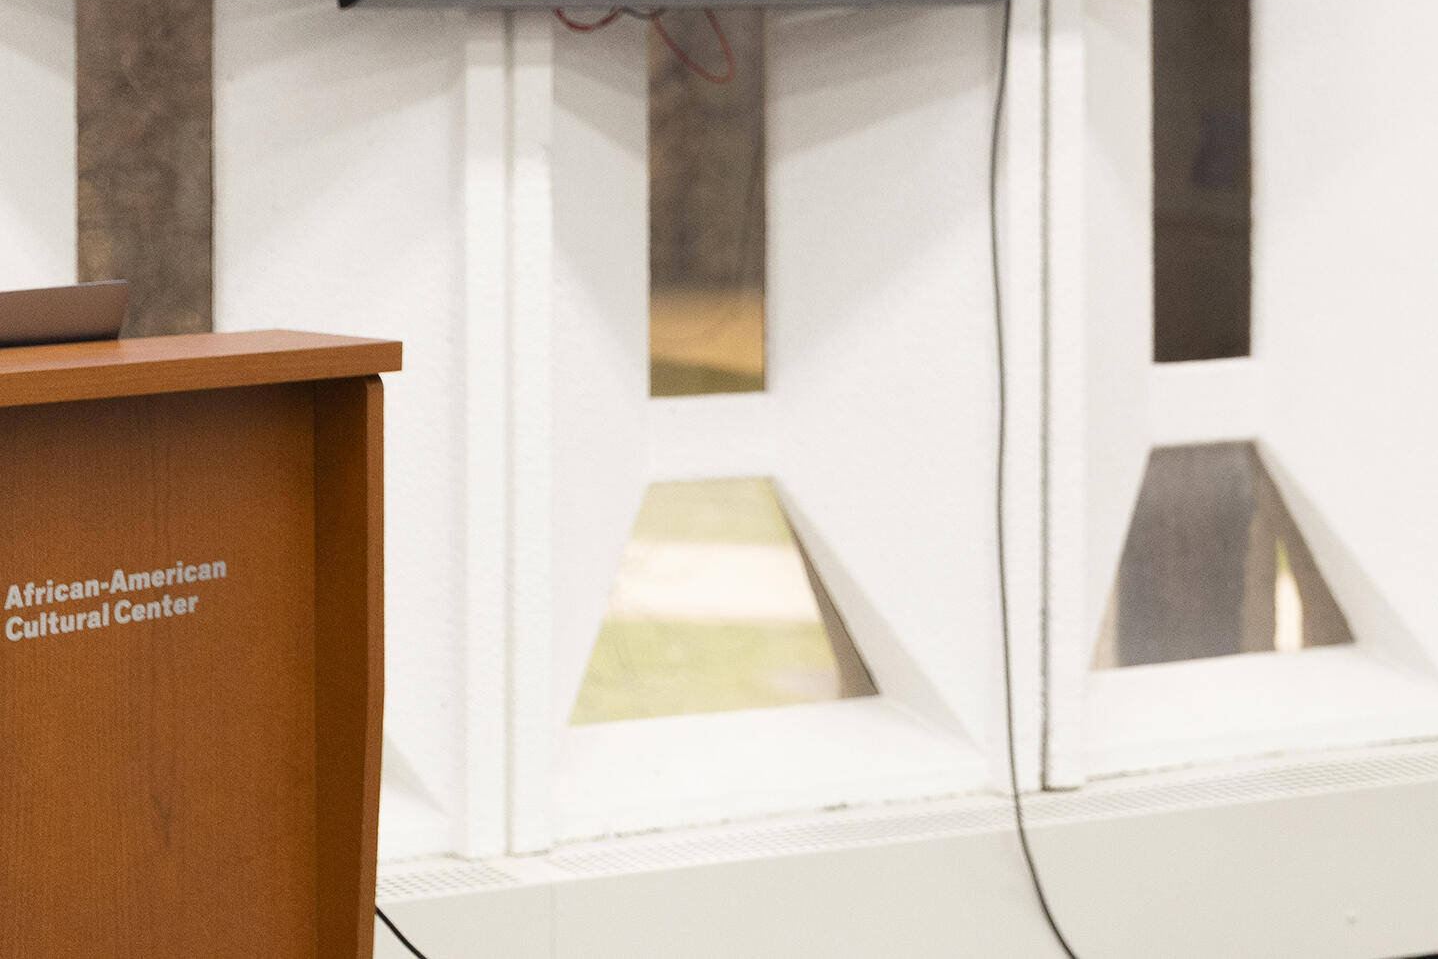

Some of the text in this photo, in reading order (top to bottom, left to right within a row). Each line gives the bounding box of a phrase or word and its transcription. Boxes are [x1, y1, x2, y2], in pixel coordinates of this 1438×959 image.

[4, 560, 227, 610] African-American
[5, 594, 199, 641] Cultural Center
